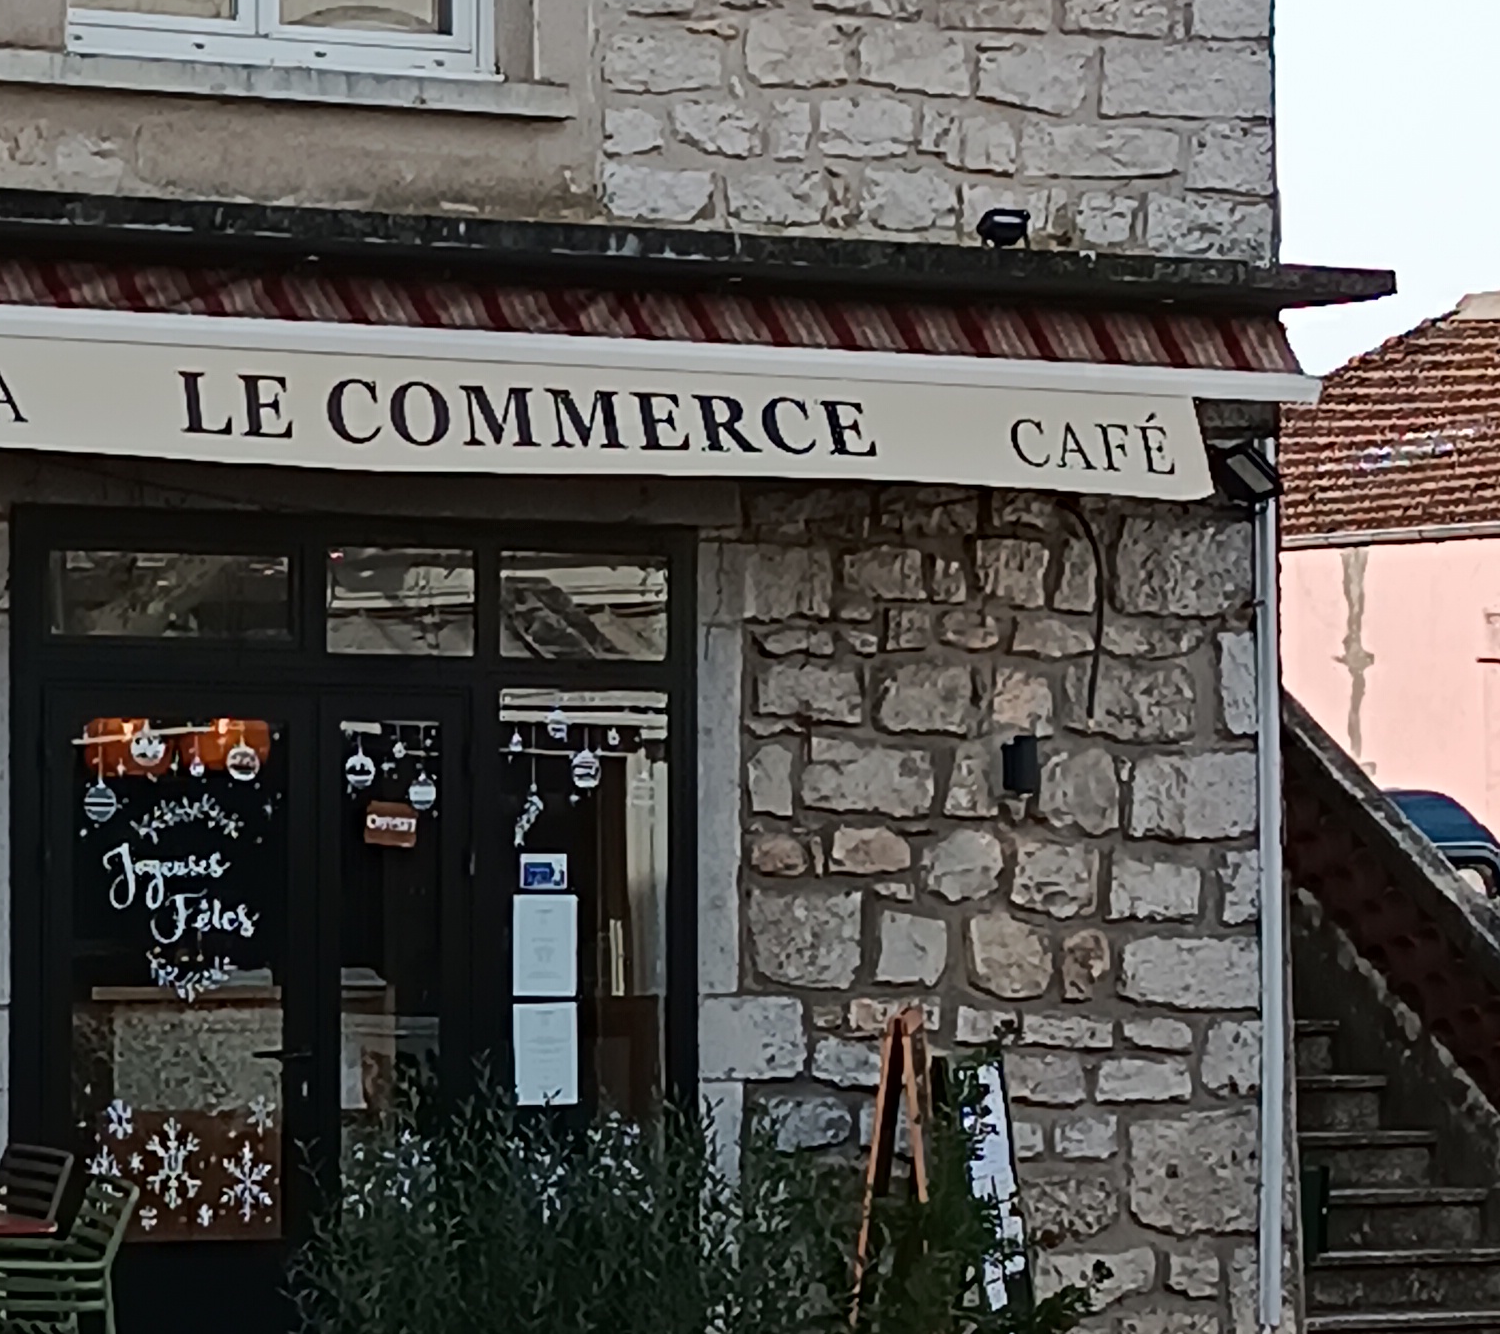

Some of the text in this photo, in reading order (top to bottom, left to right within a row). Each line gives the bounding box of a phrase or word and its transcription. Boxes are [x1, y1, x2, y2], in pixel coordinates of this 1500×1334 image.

[178, 370, 293, 439] LE
[327, 378, 877, 457] COMMERCE
[1010, 412, 1175, 475] CAFÉ
